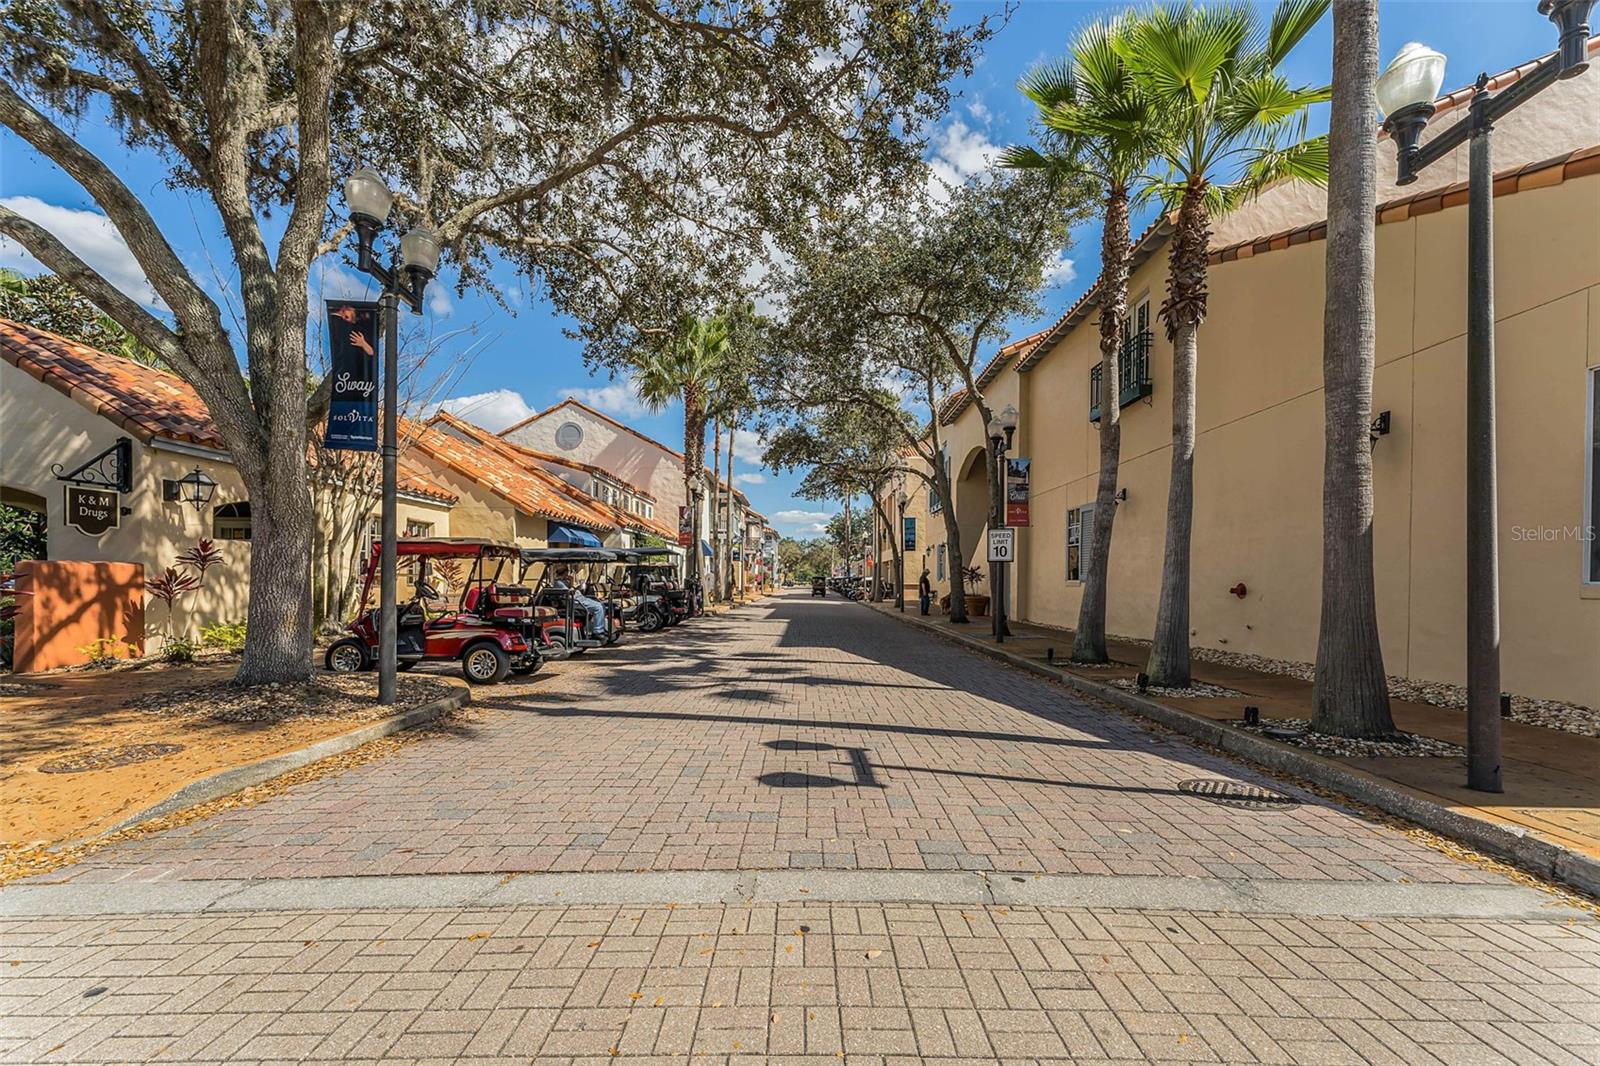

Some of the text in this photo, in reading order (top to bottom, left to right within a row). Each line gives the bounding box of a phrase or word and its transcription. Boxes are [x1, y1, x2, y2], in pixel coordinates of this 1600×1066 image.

[335, 372, 375, 398] Sway
[78, 494, 109, 506] K & M
[79, 506, 109, 520] Drugs
[993, 545, 1008, 558] 10
